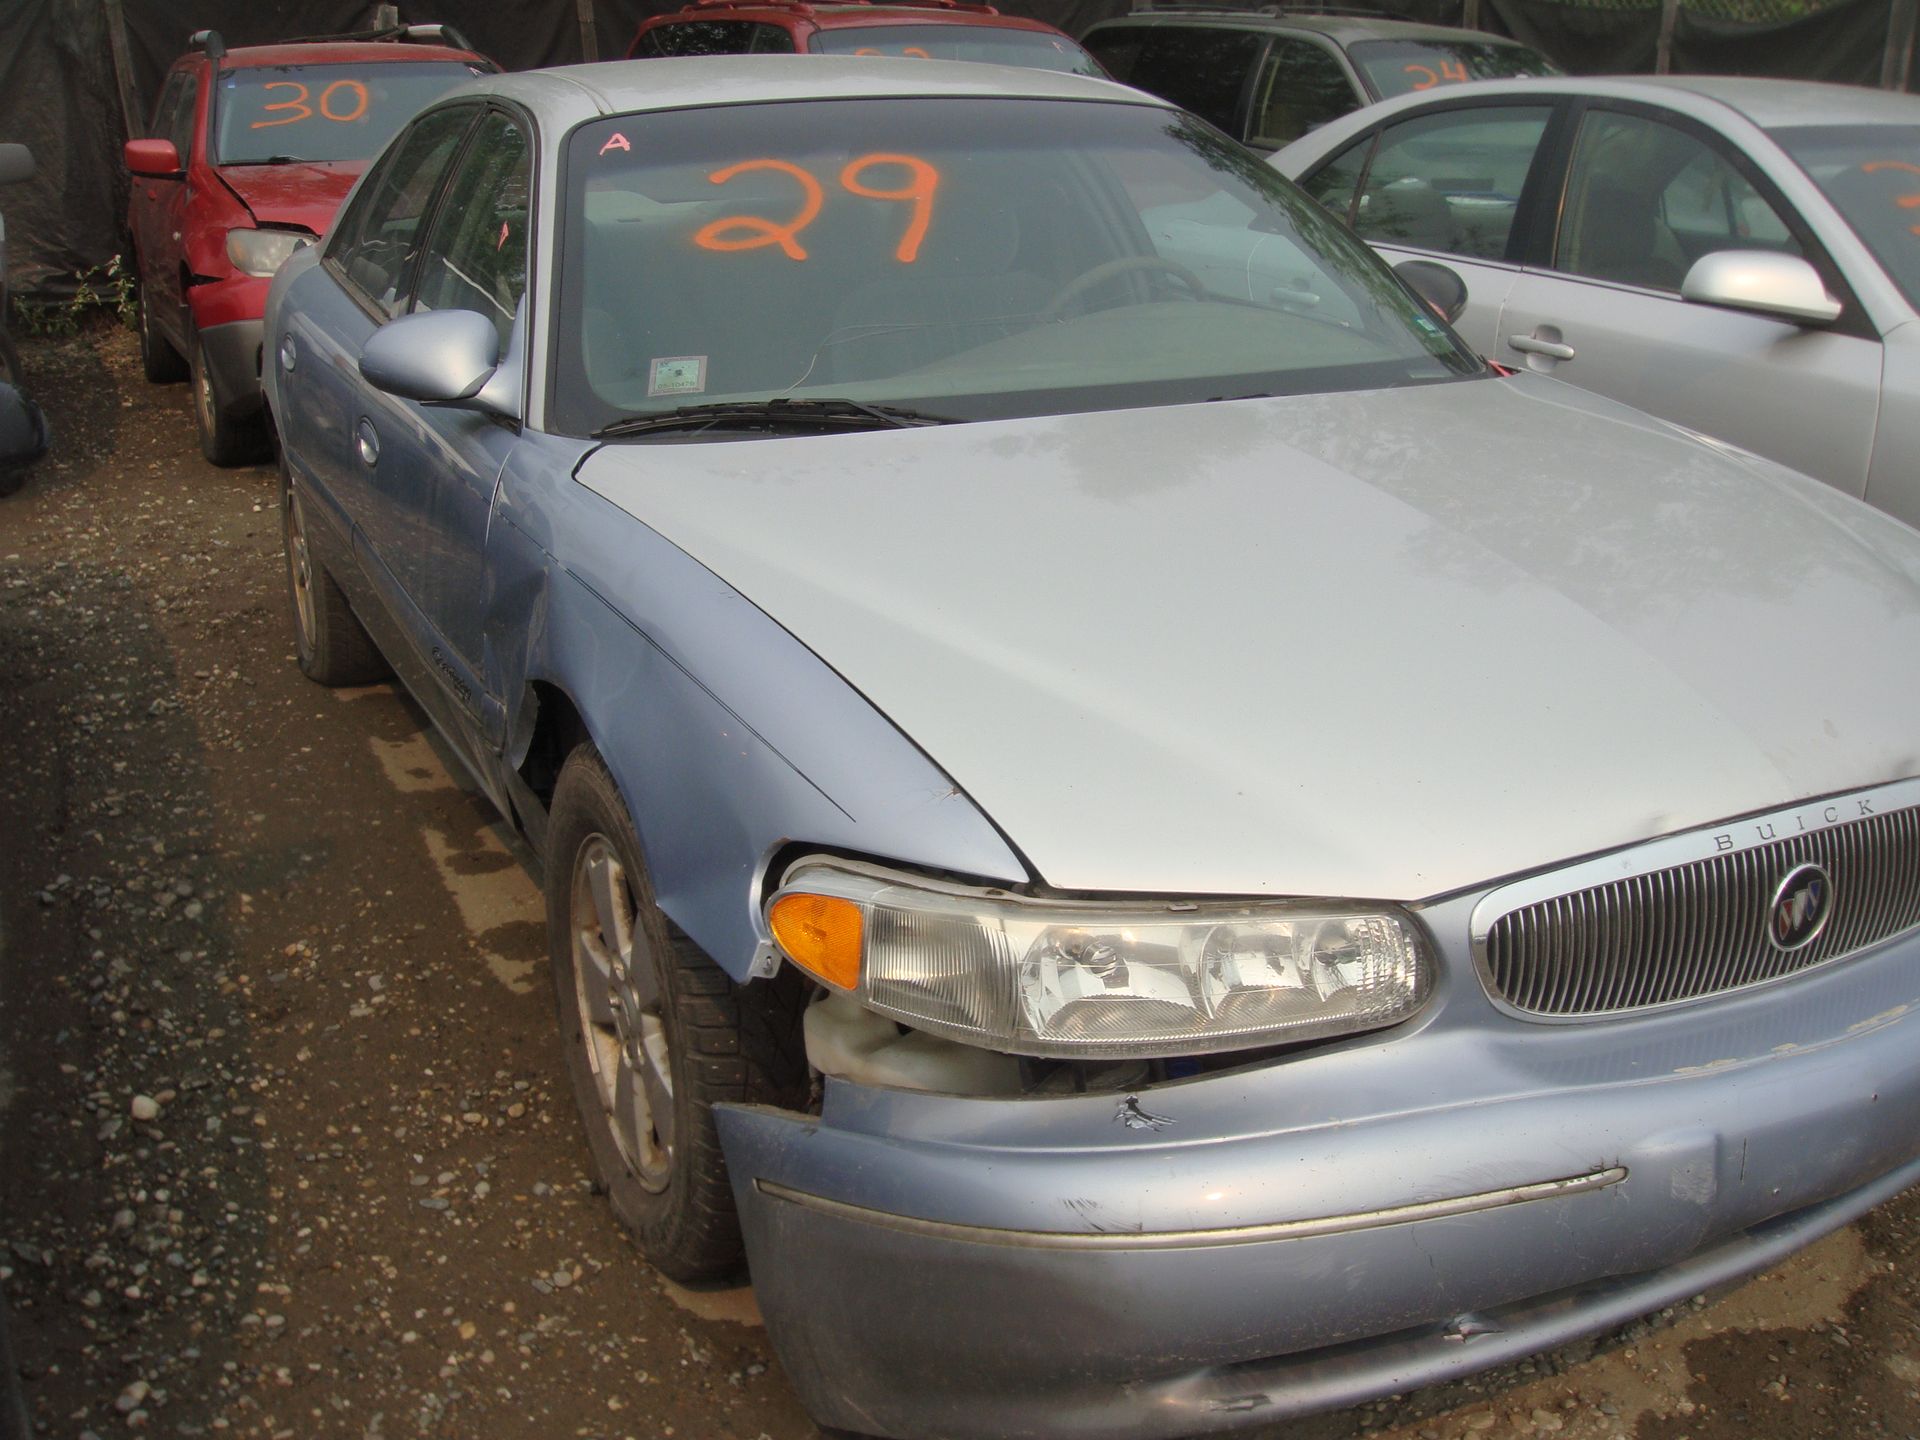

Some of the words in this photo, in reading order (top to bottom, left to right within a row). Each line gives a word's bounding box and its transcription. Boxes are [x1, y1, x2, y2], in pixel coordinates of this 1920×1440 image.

[250, 79, 369, 129] 30
[599, 132, 631, 157] A
[693, 152, 939, 263] 29
[1713, 798, 1875, 852] BUICK
